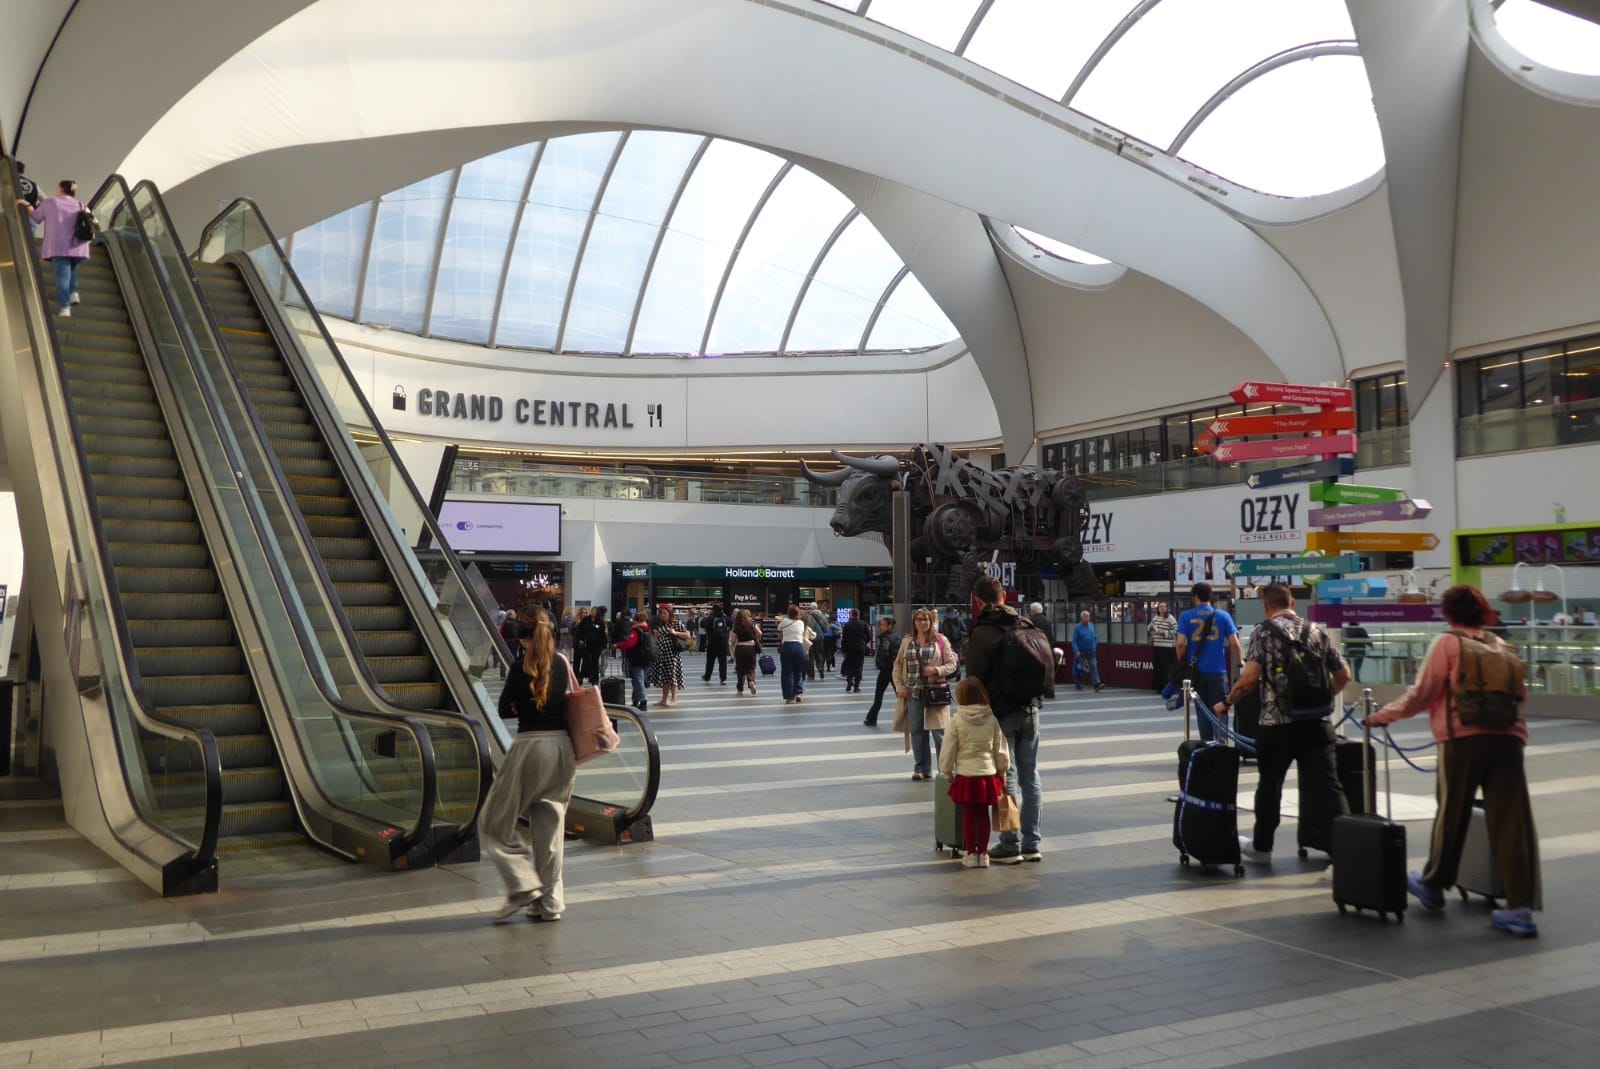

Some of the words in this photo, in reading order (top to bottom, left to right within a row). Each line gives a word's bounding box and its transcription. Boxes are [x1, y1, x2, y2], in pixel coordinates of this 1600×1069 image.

[418, 387, 504, 422] GRAND
[515, 398, 634, 429] CENTRAL
[1048, 438, 1113, 462] PIZZA
[1241, 493, 1300, 533] OZZY
[1081, 512, 1114, 545] ZZY
[725, 568, 758, 578] Holland
[765, 569, 795, 578] Barrett
[1115, 660, 1142, 670] FRESHLY
[1142, 662, 1154, 671] MA
